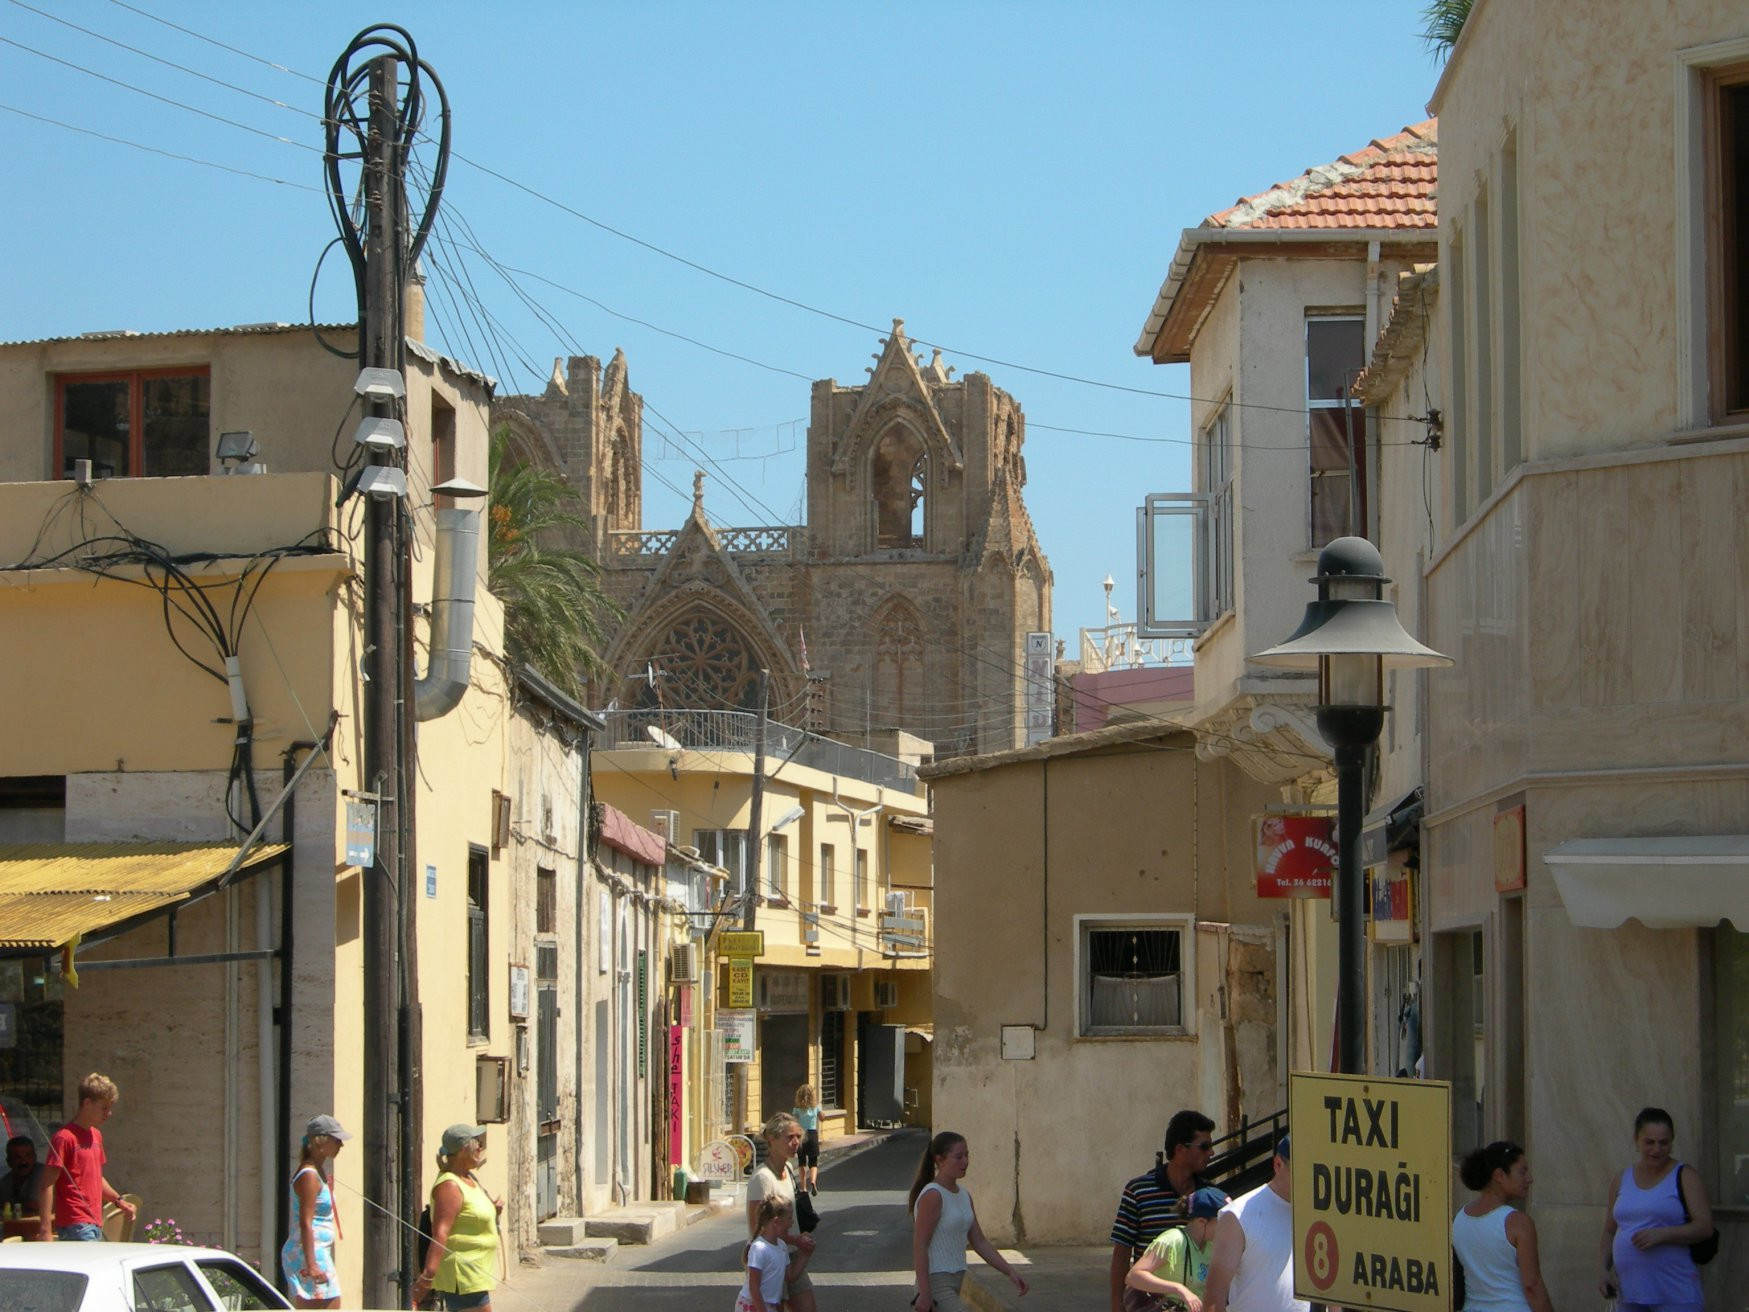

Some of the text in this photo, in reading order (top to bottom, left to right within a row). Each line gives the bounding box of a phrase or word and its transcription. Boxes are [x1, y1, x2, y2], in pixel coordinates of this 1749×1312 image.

[1324, 1096, 1399, 1149] TAXI
[1313, 1162, 1420, 1222] DURAĞI
[1313, 1232, 1439, 1297] 8 ARABA
